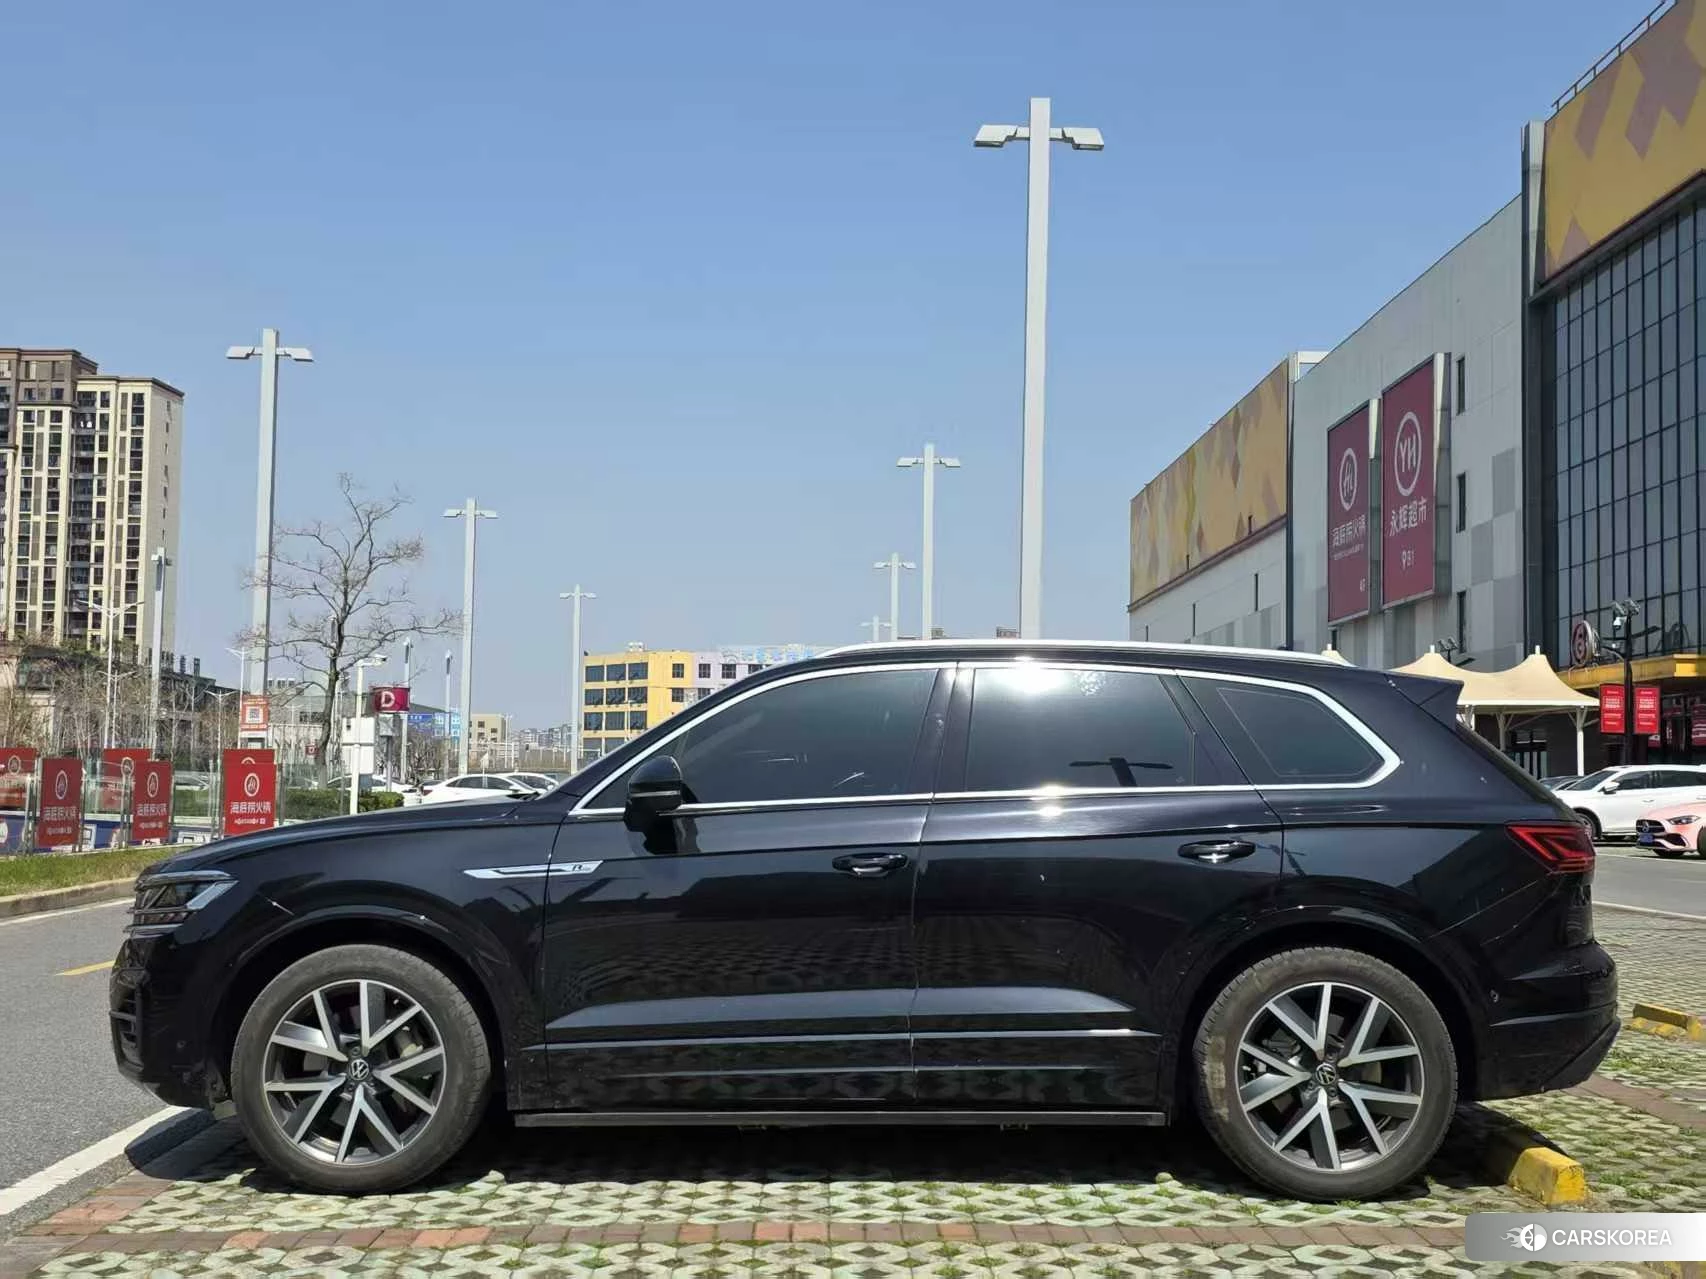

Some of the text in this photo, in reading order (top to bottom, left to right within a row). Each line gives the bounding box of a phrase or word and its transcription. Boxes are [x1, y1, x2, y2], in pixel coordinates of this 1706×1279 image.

[1400, 434, 1416, 472] YH
[1389, 496, 1428, 536] 永辉超市
[381, 691, 395, 708] D
